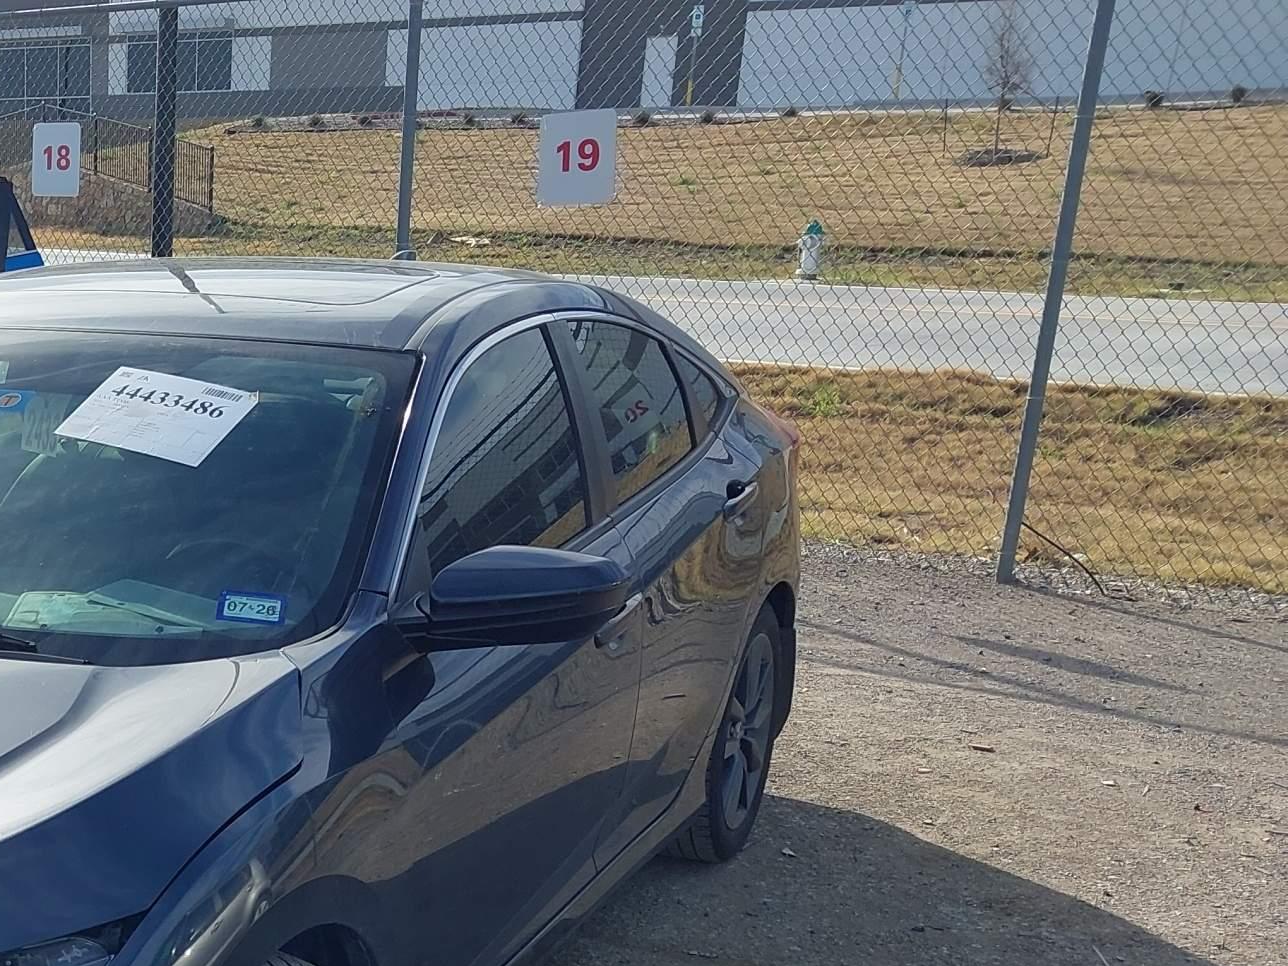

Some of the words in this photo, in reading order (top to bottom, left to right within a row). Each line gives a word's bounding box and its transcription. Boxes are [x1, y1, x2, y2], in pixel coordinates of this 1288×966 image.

[43, 144, 71, 171] 18
[556, 138, 600, 173] 19
[111, 384, 232, 419] 44433486
